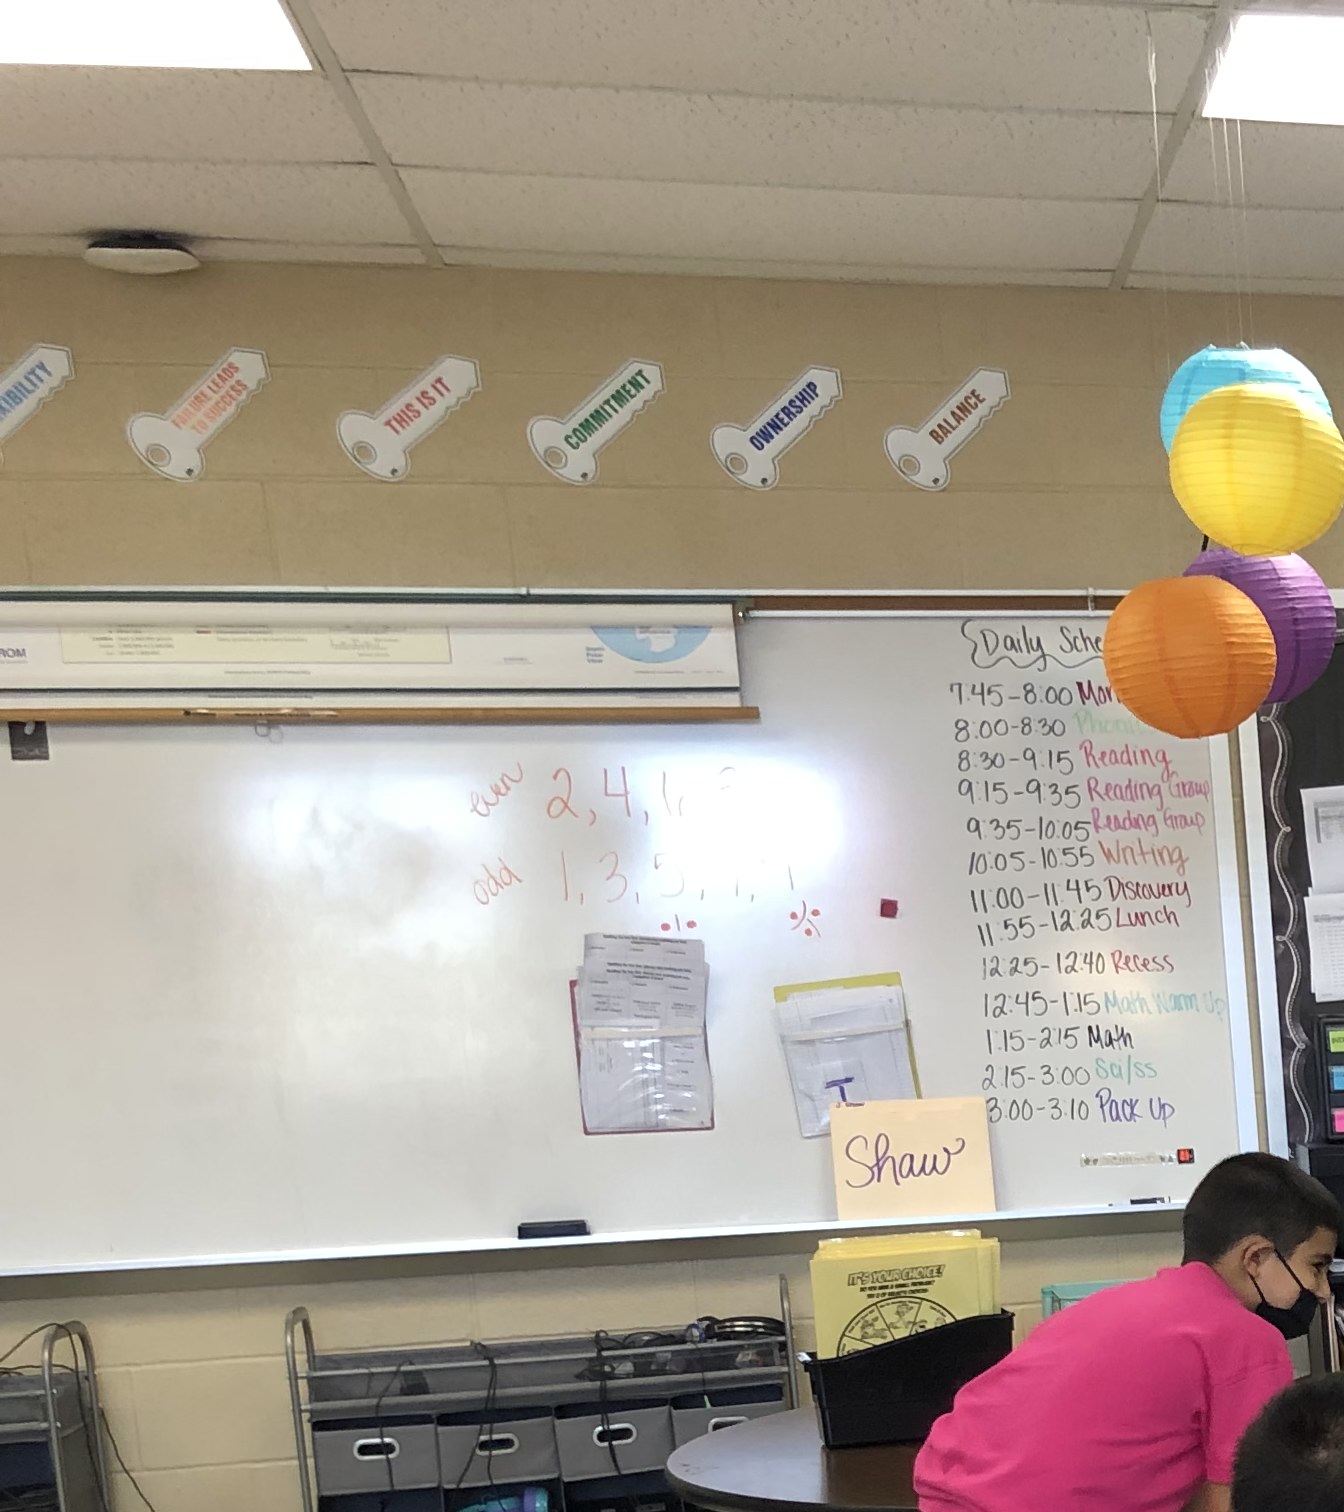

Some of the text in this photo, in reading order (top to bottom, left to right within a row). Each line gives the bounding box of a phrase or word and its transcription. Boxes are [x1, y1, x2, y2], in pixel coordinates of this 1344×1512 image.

[171, 361, 241, 430] FAILURE LEADS
[203, 378, 249, 424] SUCCESS
[384, 376, 454, 437] THIS IS IT
[564, 367, 652, 452] COMMITMENT
[749, 380, 822, 453] OWNERSHIP
[928, 387, 987, 447] BALANCE
[980, 625, 1048, 672] Daily
[1079, 739, 1173, 782] Reading
[1087, 775, 1164, 811] Reading
[1168, 771, 1211, 806] Group
[1091, 807, 1157, 839] Reading
[1162, 808, 1207, 838] Group
[1098, 839, 1190, 877] Writing
[472, 858, 523, 906] odd
[1104, 875, 1192, 909] Discovery
[1114, 906, 1181, 929] Lunch
[1110, 949, 1175, 975] Recess
[1087, 1023, 1136, 1050] Math
[1094, 1087, 1143, 1124] Pack
[1150, 1096, 1176, 1129] Up
[844, 1132, 966, 1189] Shaw
[847, 1264, 946, 1286] IT'S YOUR CHOICE!
